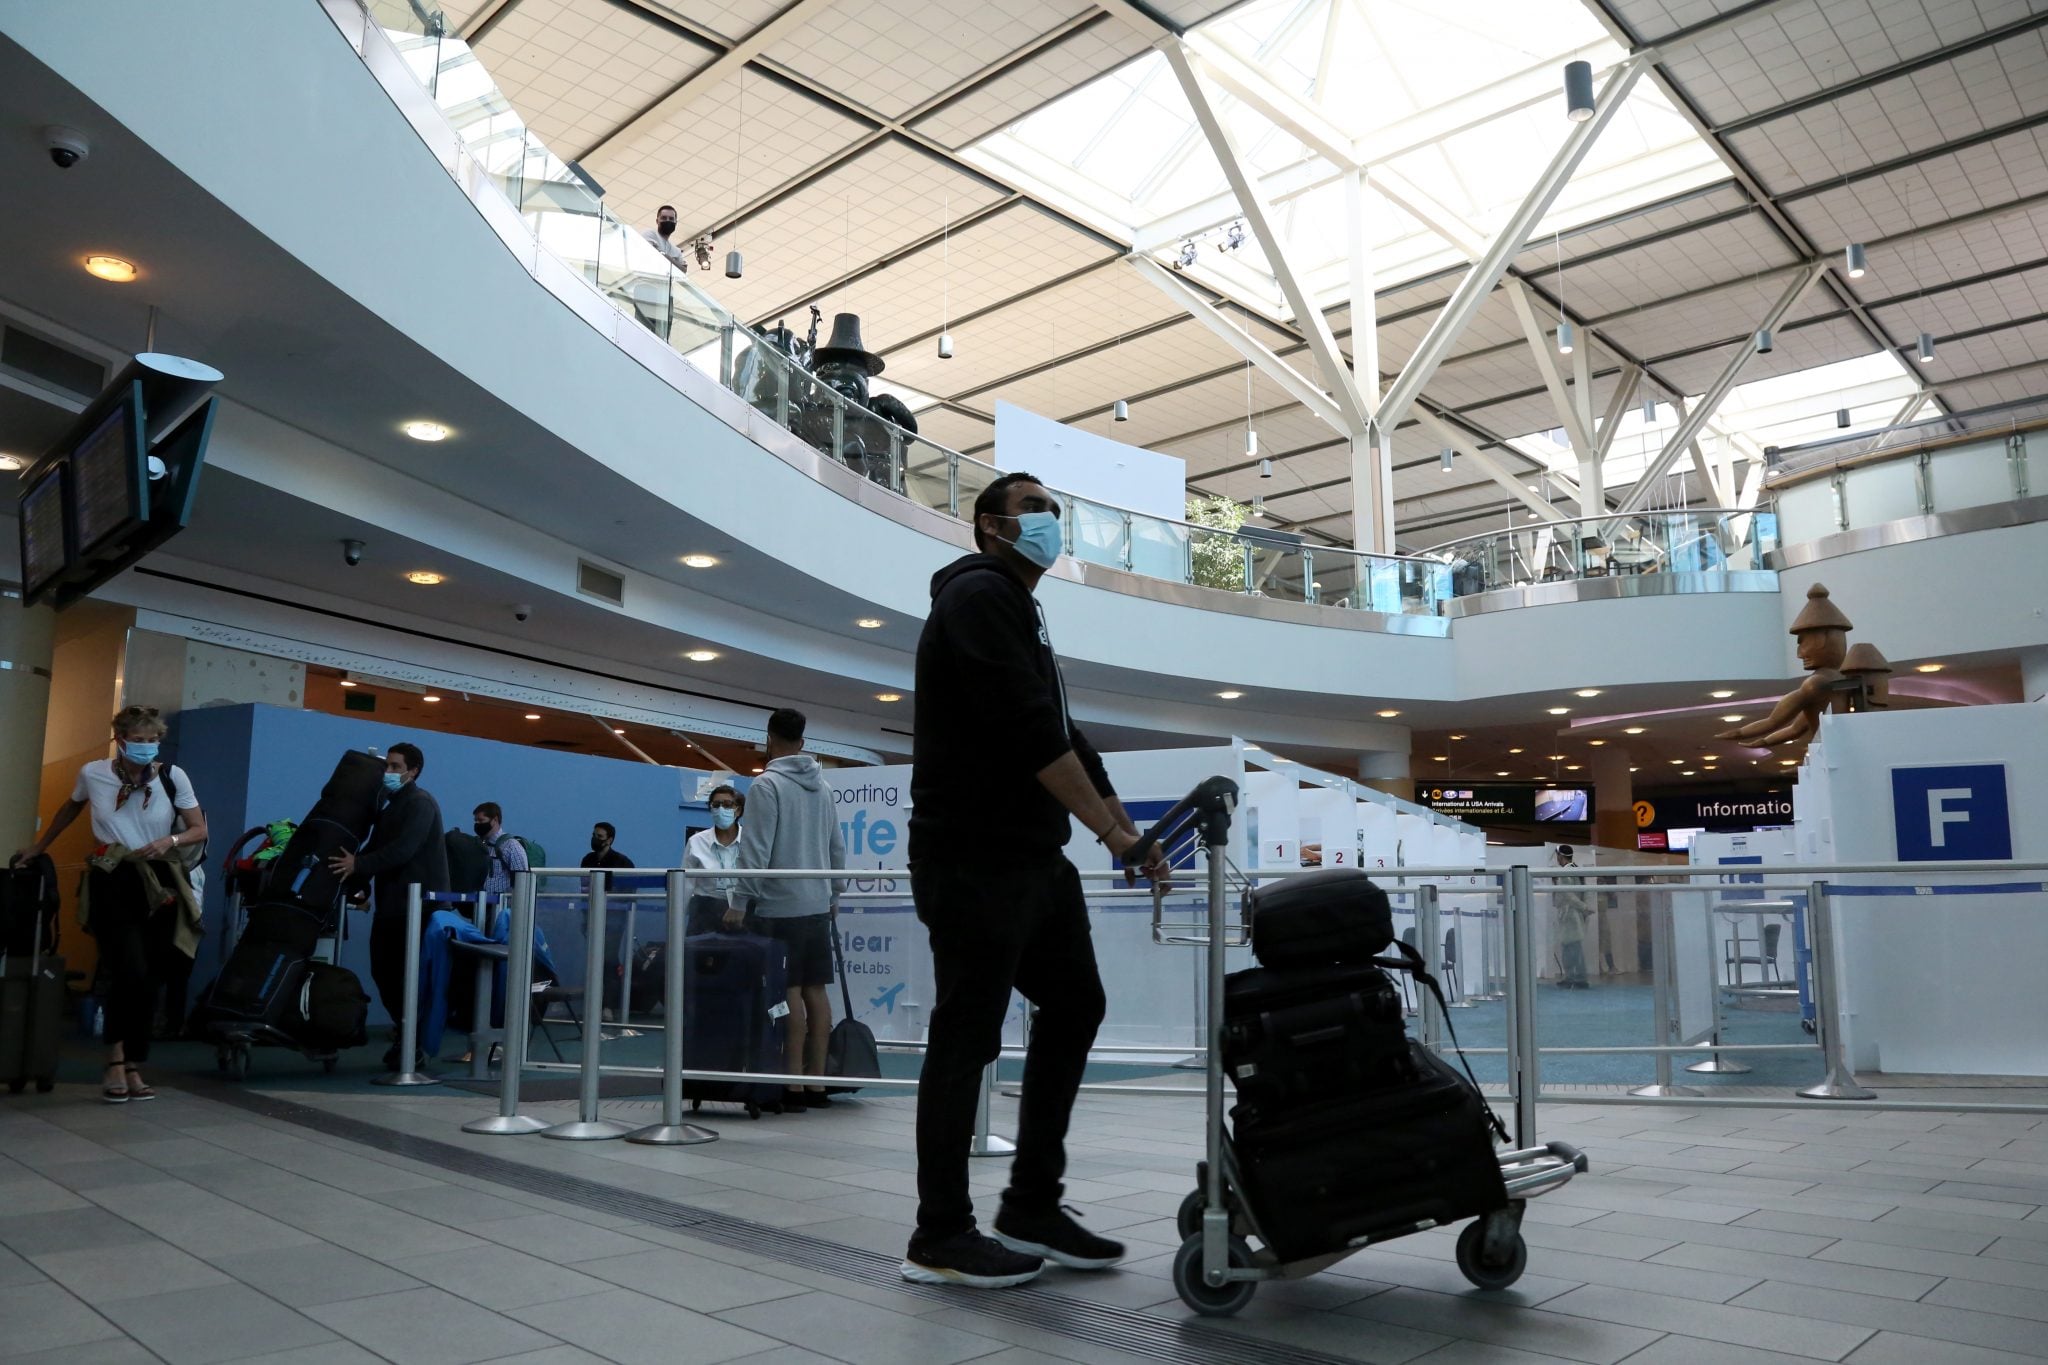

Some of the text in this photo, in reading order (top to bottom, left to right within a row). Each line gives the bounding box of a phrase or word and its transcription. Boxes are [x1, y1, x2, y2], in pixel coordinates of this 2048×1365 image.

[1927, 788, 1972, 847] F
[1276, 844, 1283, 858] 1
[1335, 852, 1344, 864] 2
[1470, 876, 1476, 885] 6
[838, 931, 893, 952] lear
[834, 960, 891, 975] LfeLabs
